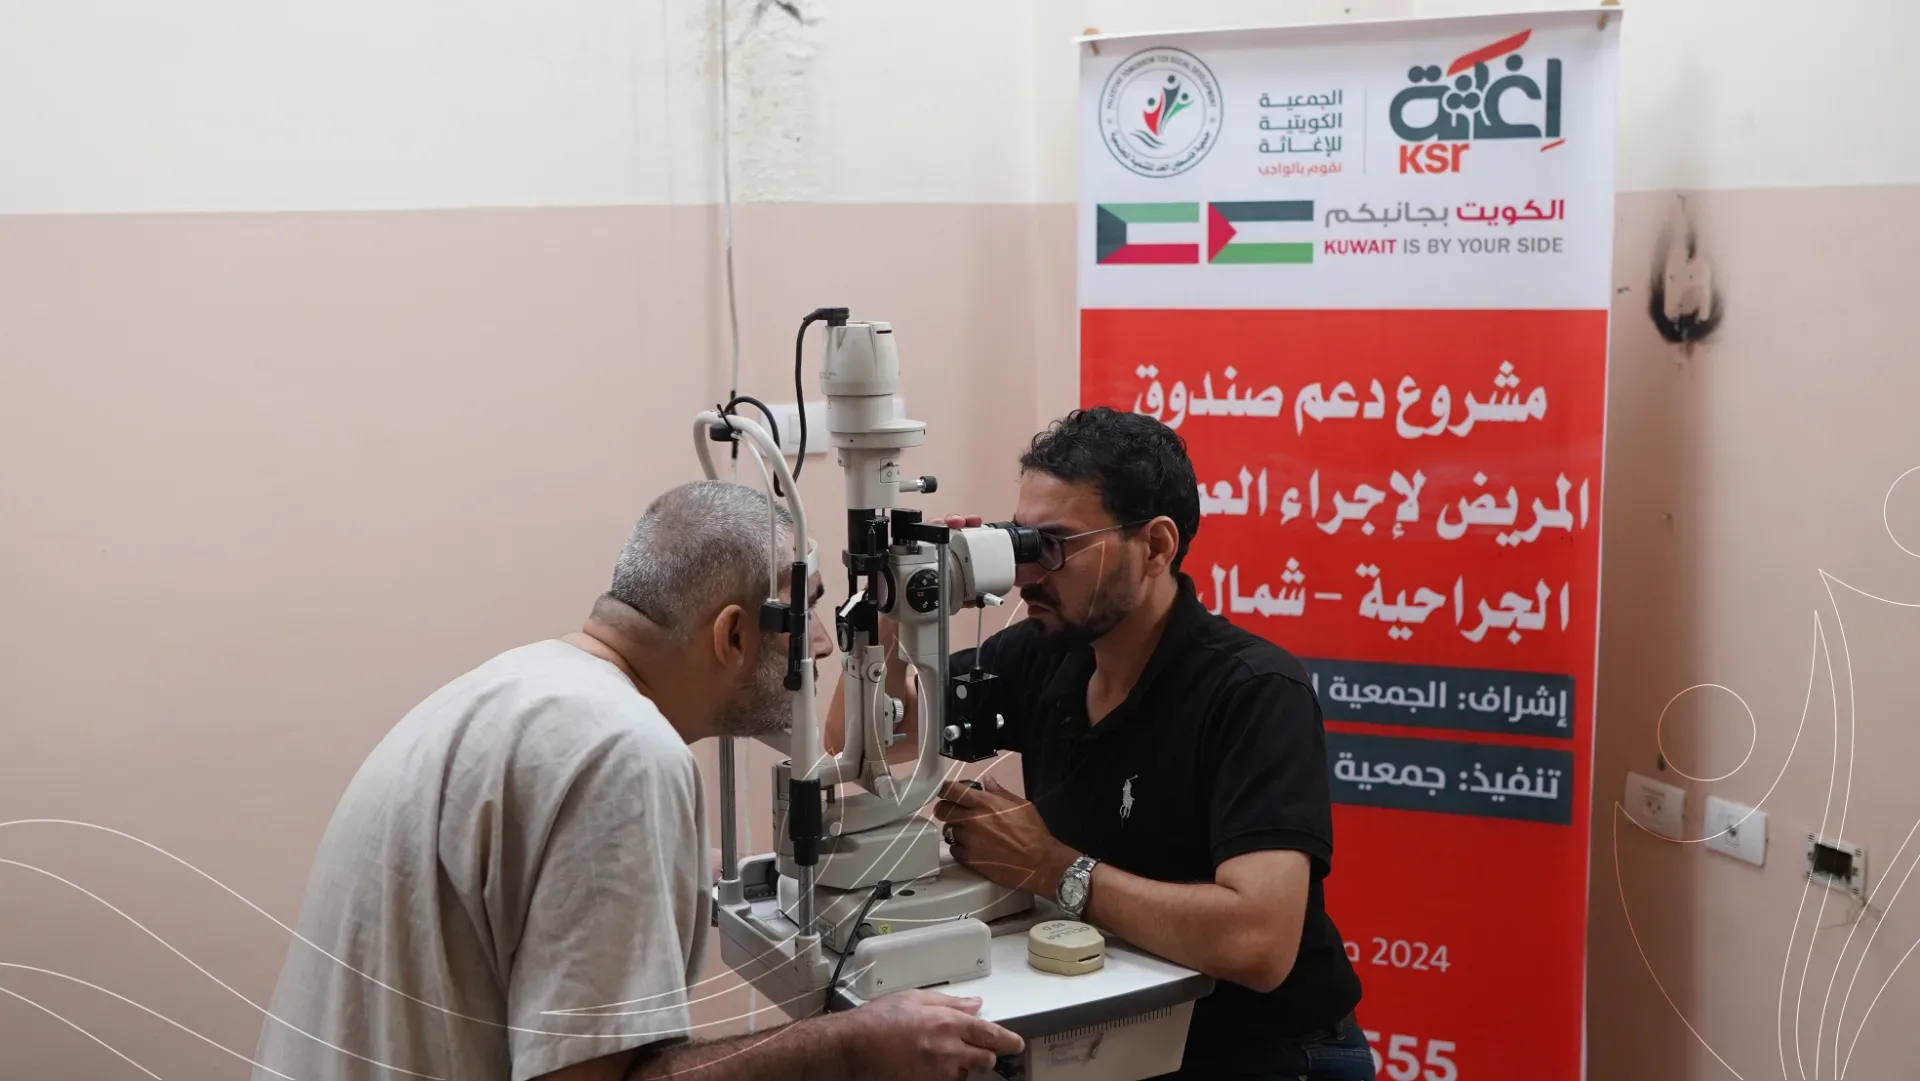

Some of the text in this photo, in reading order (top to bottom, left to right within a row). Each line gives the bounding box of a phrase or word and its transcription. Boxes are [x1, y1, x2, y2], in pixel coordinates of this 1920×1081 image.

[1259, 89, 1342, 111] الجمعية
[1259, 112, 1342, 135] الكويتية
[1259, 135, 1342, 158] للإغاثة
[1325, 199, 1565, 228] الكويت بجانبكم
[1324, 237, 1564, 255] KUWAIT IS BY YOUR SIDE
[1133, 360, 1547, 439] مشروع دعم صندوق
[1280, 469, 1427, 539] لإجراء
[1436, 472, 1590, 547] المريض
[1358, 562, 1570, 645] الجراحية
[1329, 676, 1447, 714] الجمعية
[1458, 685, 1568, 728] إشراف:
[1334, 752, 1562, 803] تنفيذ: جمعية
[1371, 936, 1452, 973] 2024
